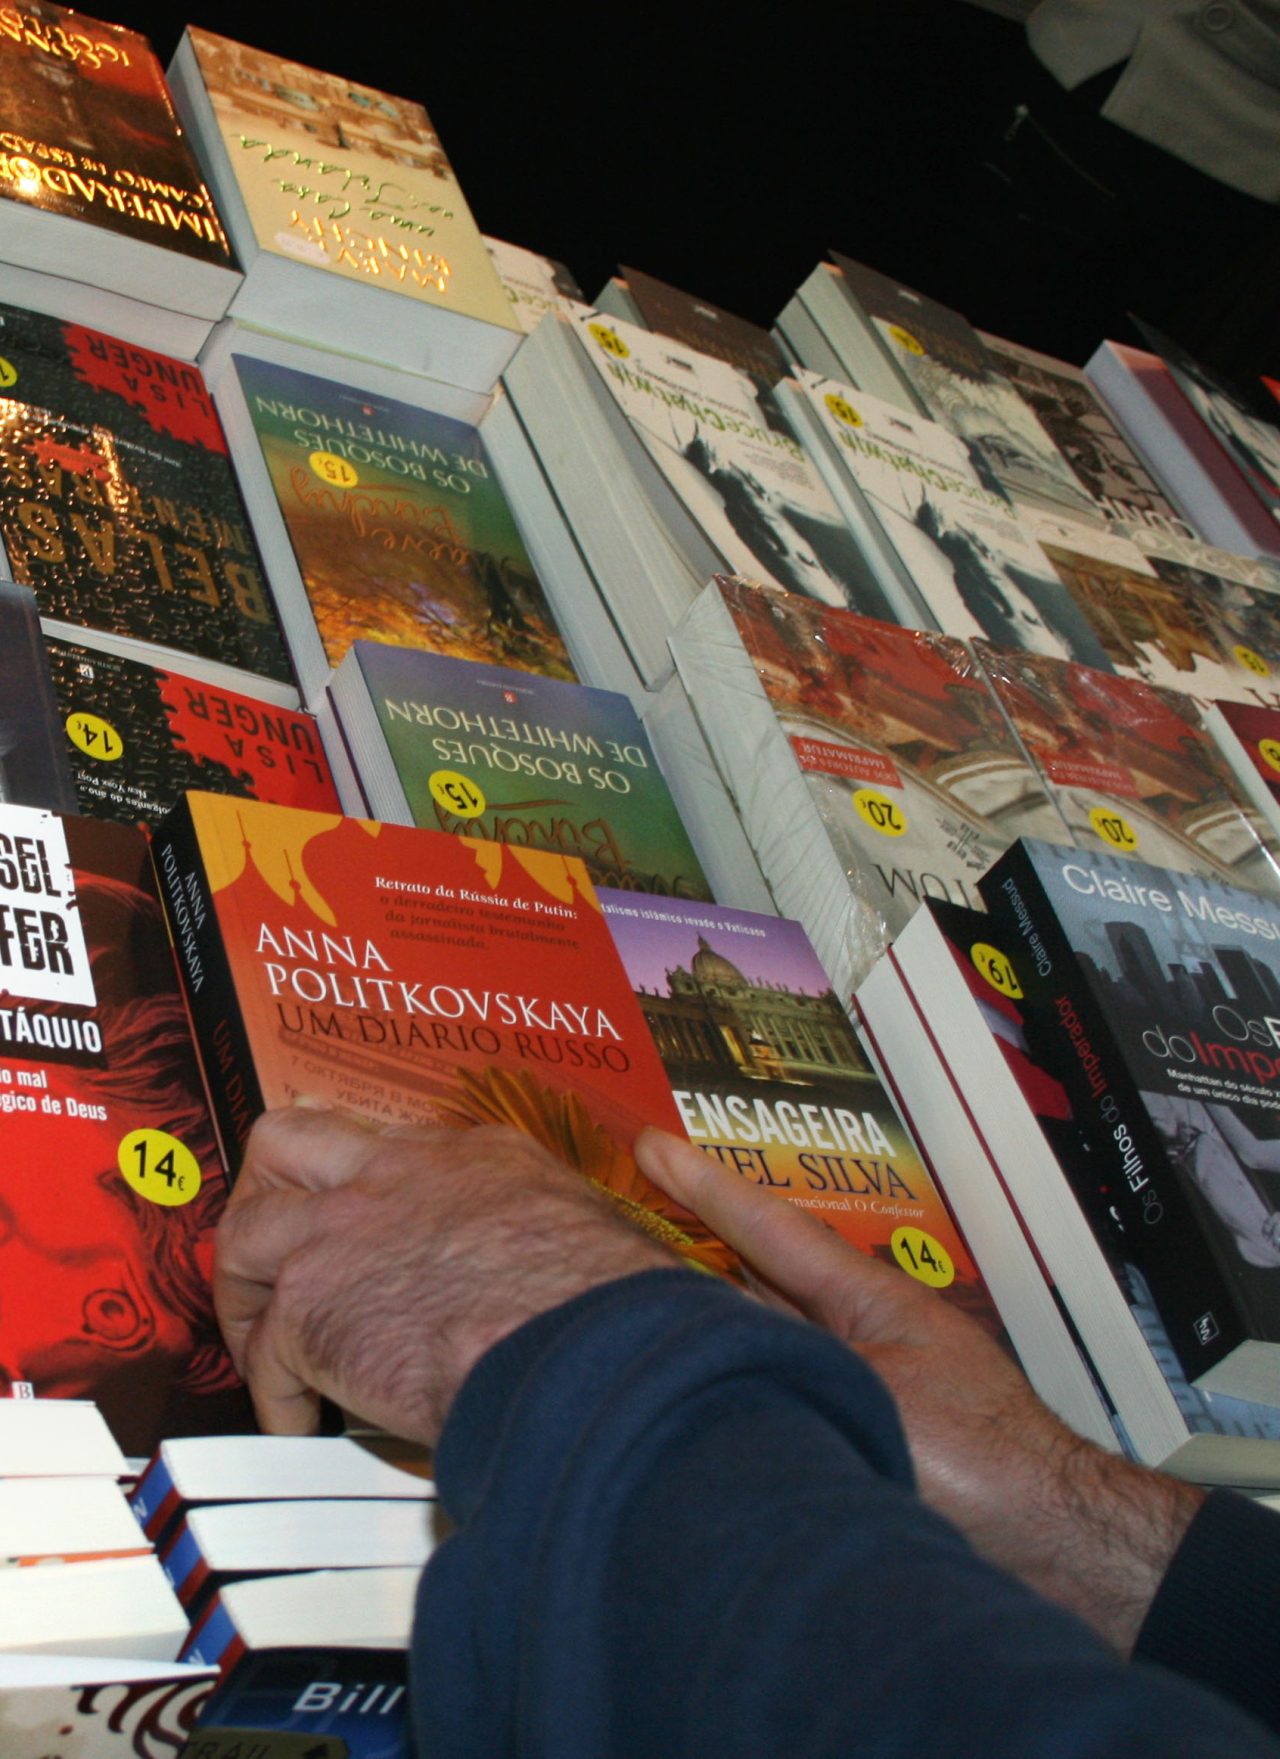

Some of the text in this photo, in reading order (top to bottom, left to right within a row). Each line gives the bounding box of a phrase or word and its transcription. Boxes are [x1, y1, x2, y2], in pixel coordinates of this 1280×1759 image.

[84, 335, 204, 393] UNGER
[122, 375, 209, 417] LISA
[254, 395, 448, 466] WHITETHORN
[294, 428, 470, 494] OS BOSQUES
[454, 454, 489, 480] DE
[20, 501, 267, 624] BELAS
[183, 687, 315, 755] UNGER
[384, 698, 648, 769] DE WHITETHORN
[224, 734, 325, 784] LISA
[431, 737, 631, 795] OS BOSQUES
[184, 871, 208, 931] ANNA
[375, 876, 579, 920] Retrato da Rússia de Putin:
[393, 894, 475, 918] derradeiro
[1062, 863, 1173, 912] Claire
[160, 842, 205, 994] POLITKOVSKAYA
[384, 909, 581, 950] da jornalista brutalmente
[1001, 876, 1052, 977] Claire Messud
[255, 922, 393, 973] ANNA
[264, 961, 624, 1042] POLITKOVSKAYA
[277, 1002, 631, 1074] UM DIÁRIO RUSSO
[1055, 994, 1109, 1099] Imperador
[17, 1067, 49, 1090] mal
[41, 1092, 63, 1117] de
[67, 1096, 109, 1123] Deus
[672, 1090, 898, 1158] ENSAGEIRA
[798, 1153, 919, 1200] SILVA
[1113, 1123, 1150, 1193] Filhos
[853, 1200, 926, 1219] O Confessor
[292, 1682, 405, 1715] Bill
